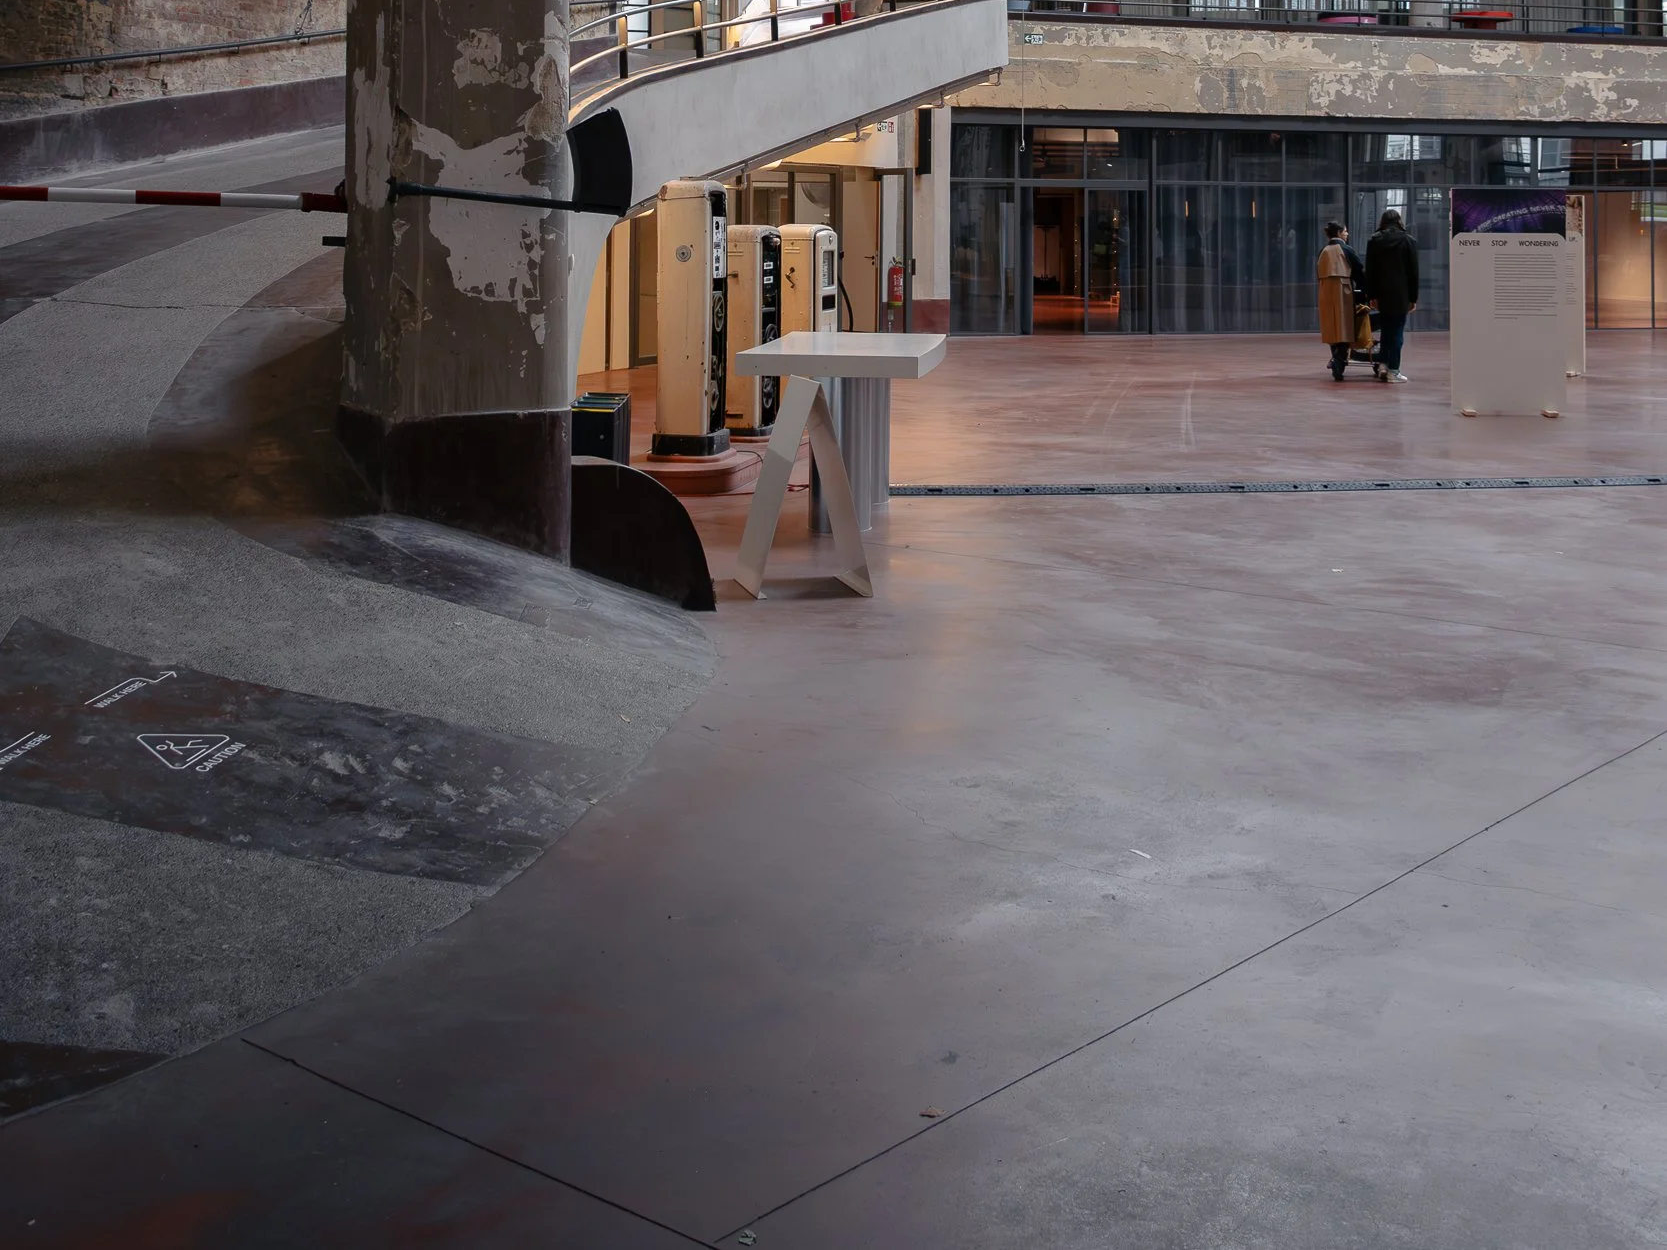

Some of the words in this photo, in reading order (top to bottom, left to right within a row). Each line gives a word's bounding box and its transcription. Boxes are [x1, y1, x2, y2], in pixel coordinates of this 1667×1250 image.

[93, 693, 126, 708] WALK
[119, 680, 147, 695] HERE
[21, 733, 52, 750] HERE
[195, 741, 247, 773] CAUTION
